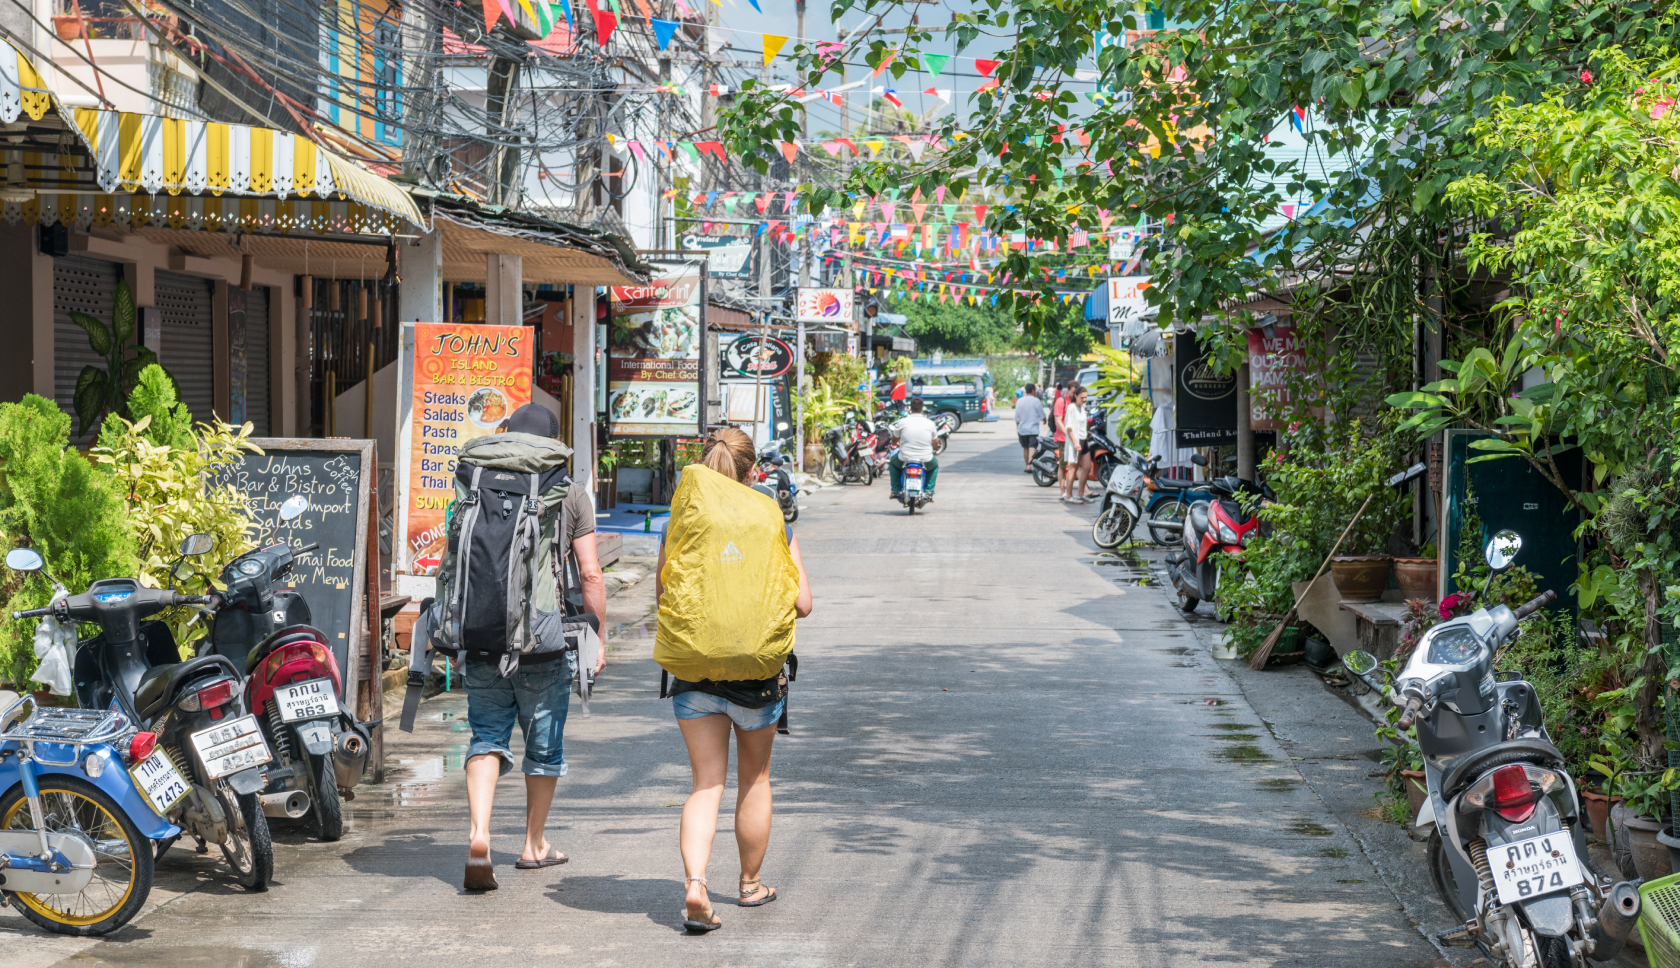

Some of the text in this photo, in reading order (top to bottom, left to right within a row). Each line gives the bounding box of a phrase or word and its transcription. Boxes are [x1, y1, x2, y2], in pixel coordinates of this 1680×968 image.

[430, 332, 520, 357] JOHN'S
[740, 341, 783, 355] Casa Ialiana
[1262, 338, 1284, 351] WE
[450, 359, 498, 371] ISLAND
[621, 360, 698, 370] International Food
[432, 373, 515, 387] BAR & BISTRO
[641, 370, 698, 380] By Chef God
[423, 391, 466, 406] Steaks
[423, 408, 464, 422] Salads
[1252, 405, 1295, 420] SHP
[422, 425, 457, 439] Pasta
[1183, 430, 1222, 440] Thailand
[422, 442, 458, 455] Tapas
[257, 455, 312, 476] Johns
[334, 453, 360, 484] Fresh
[421, 459, 444, 473] Bar
[236, 471, 336, 495] Bar & Bistro
[323, 460, 353, 494] Coffee
[420, 475, 447, 489] Thai
[308, 494, 351, 522] Import
[416, 495, 453, 510] SUND
[259, 527, 303, 548] Pasta
[326, 548, 354, 567] Food
[312, 566, 350, 585] Menu
[295, 704, 326, 718] 863
[156, 781, 185, 809] 7473
[1512, 825, 1536, 835] HONDA
[1517, 871, 1564, 896] 874
